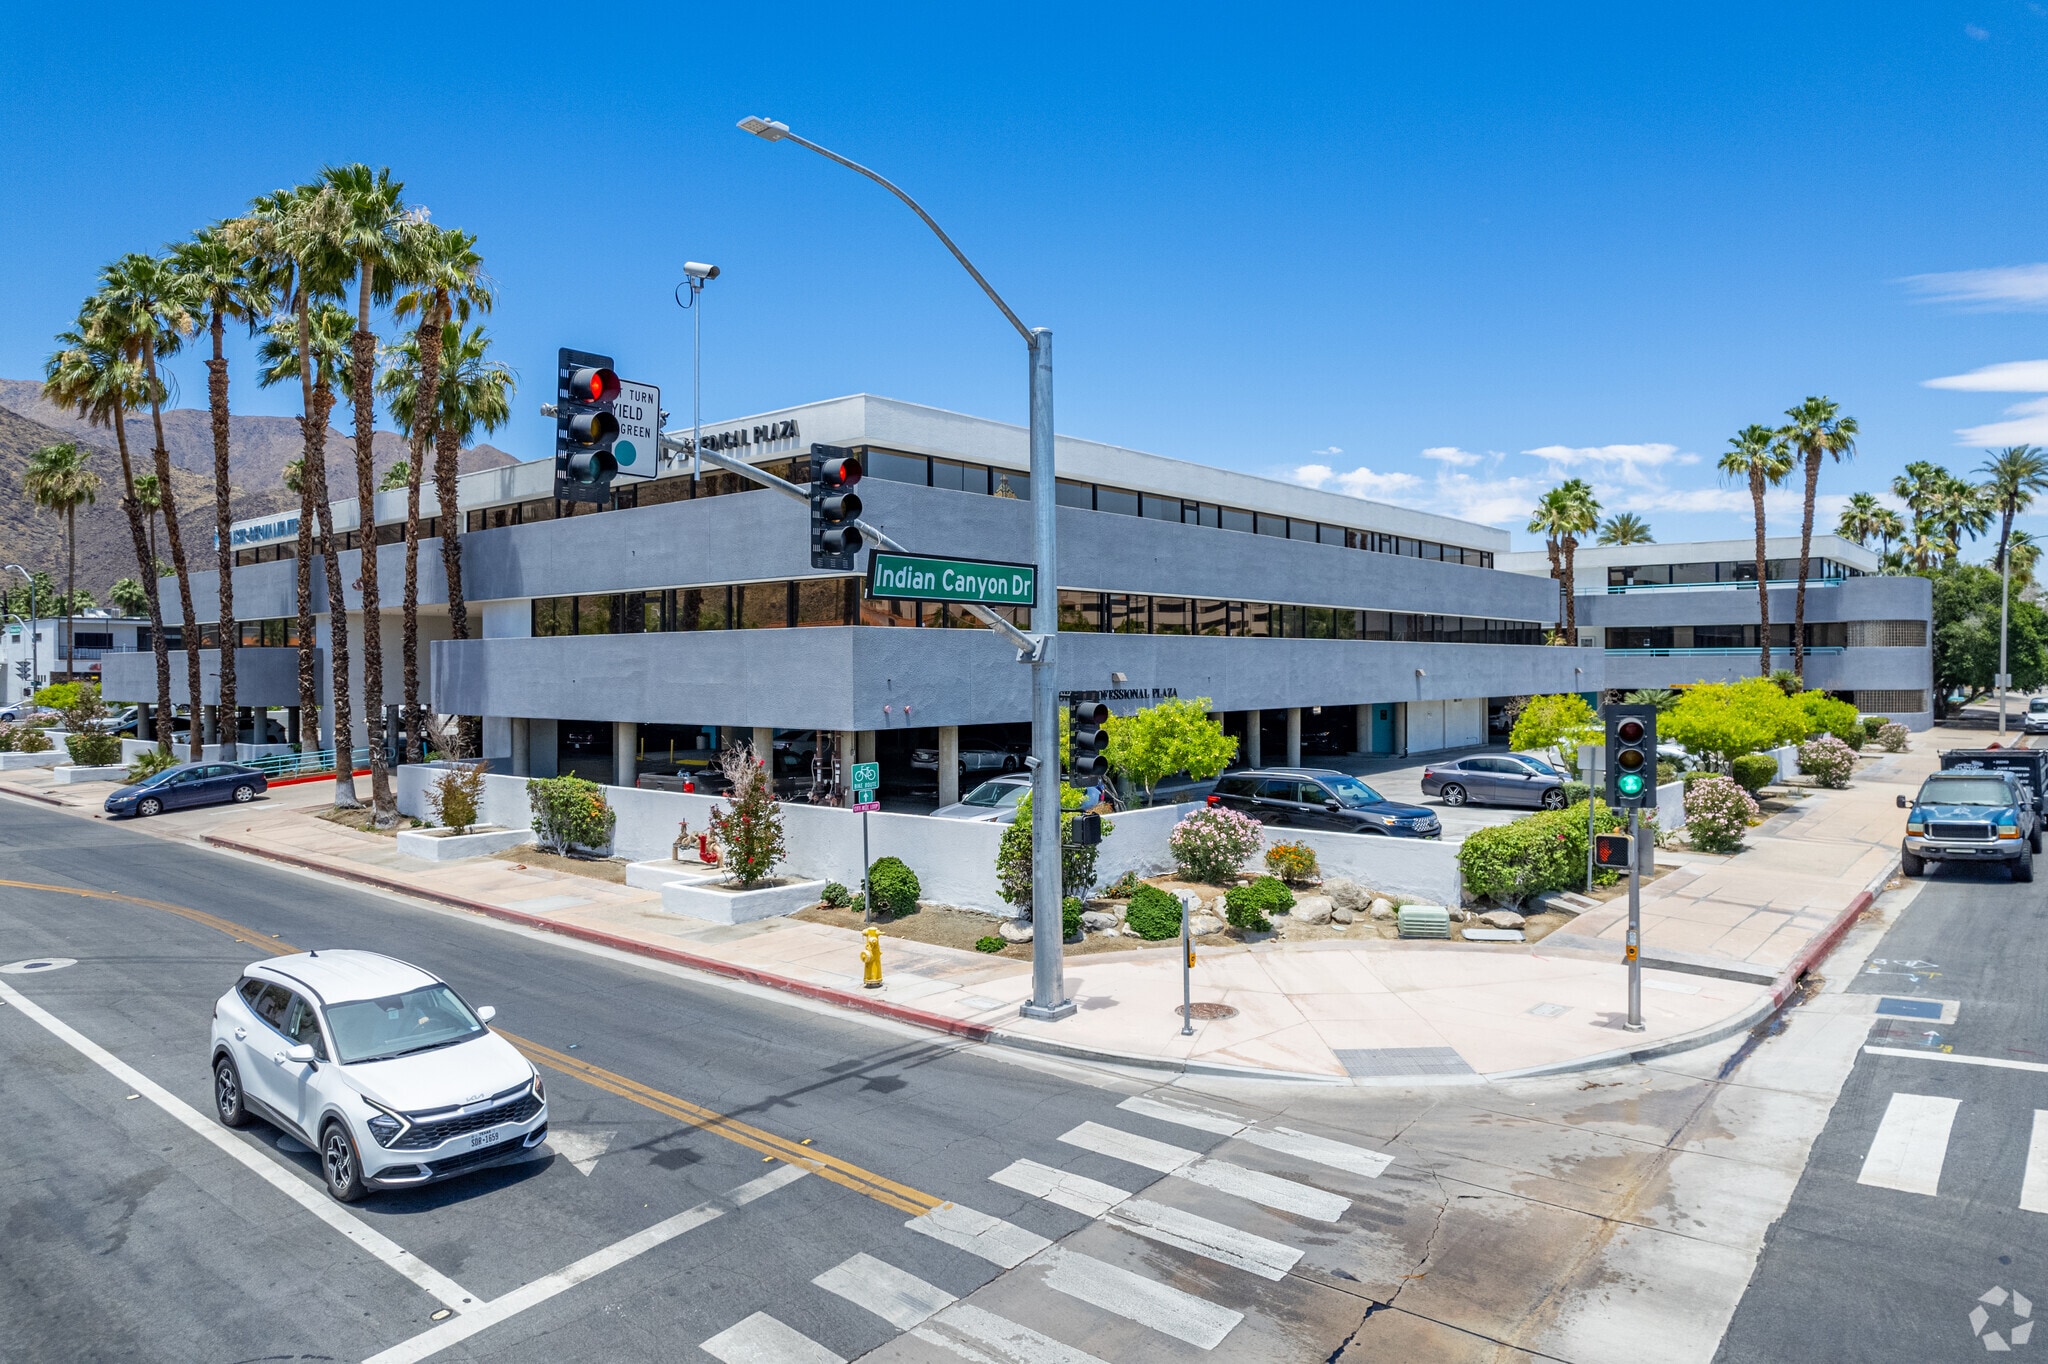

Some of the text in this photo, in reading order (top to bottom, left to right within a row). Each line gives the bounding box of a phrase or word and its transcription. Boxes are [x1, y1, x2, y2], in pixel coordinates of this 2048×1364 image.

[629, 389, 654, 404] TURN
[613, 403, 643, 421] YIELD
[620, 423, 651, 438] GREEN
[698, 419, 800, 451] EDICAL PLAZA
[876, 563, 1031, 599] Indian Canyon Dr
[1100, 688, 1149, 700] OFESSIONAL
